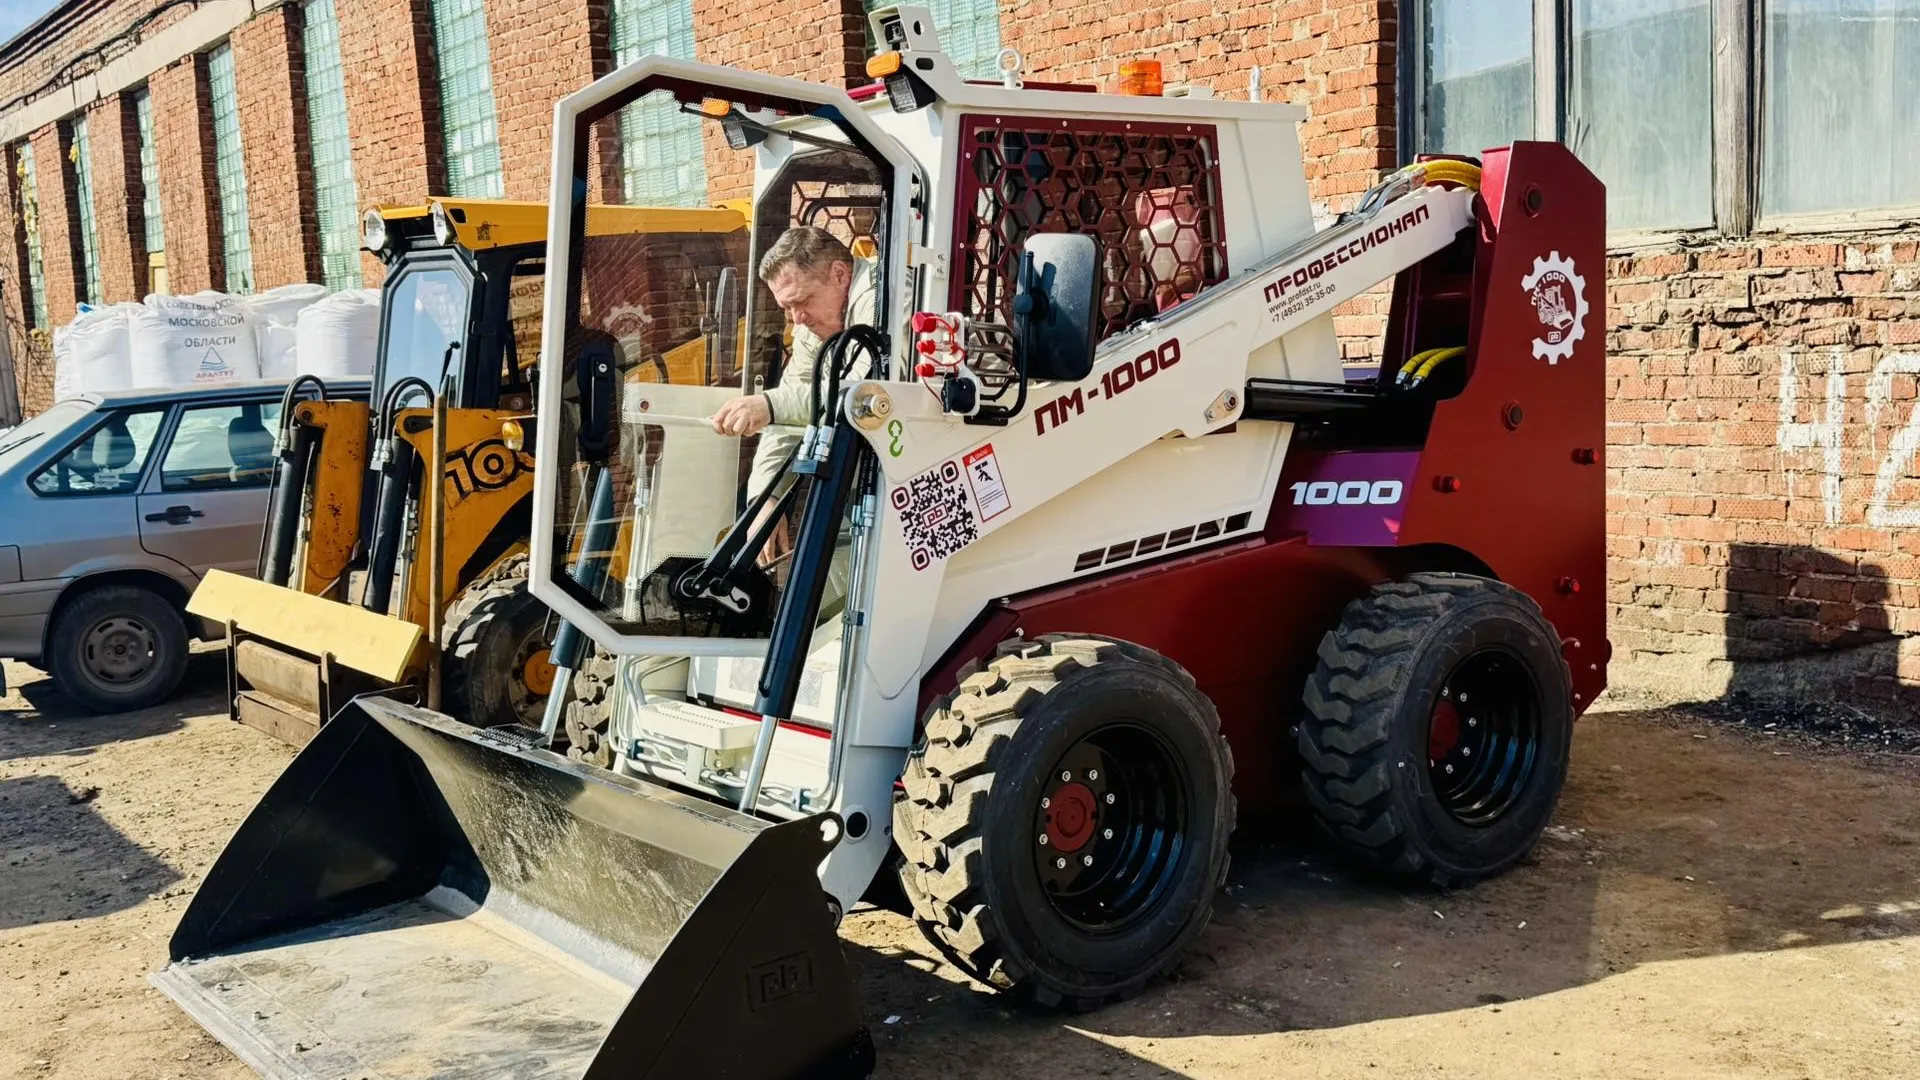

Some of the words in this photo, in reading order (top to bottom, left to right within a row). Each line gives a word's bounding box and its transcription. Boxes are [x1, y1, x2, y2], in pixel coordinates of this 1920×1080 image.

[1264, 204, 1430, 303] ПРОФЕССИОНАЛ
[1268, 281, 1321, 314] www.profdst.ru
[1281, 302, 1305, 322] (4932)
[1305, 284, 1336, 308] 35-35-00
[168, 313, 245, 328] МОСКОВСКОЙ
[184, 336, 236, 348] ОБЛАСТИ
[1034, 337, 1181, 436] ПМ-1000
[1289, 480, 1403, 505] 1000
